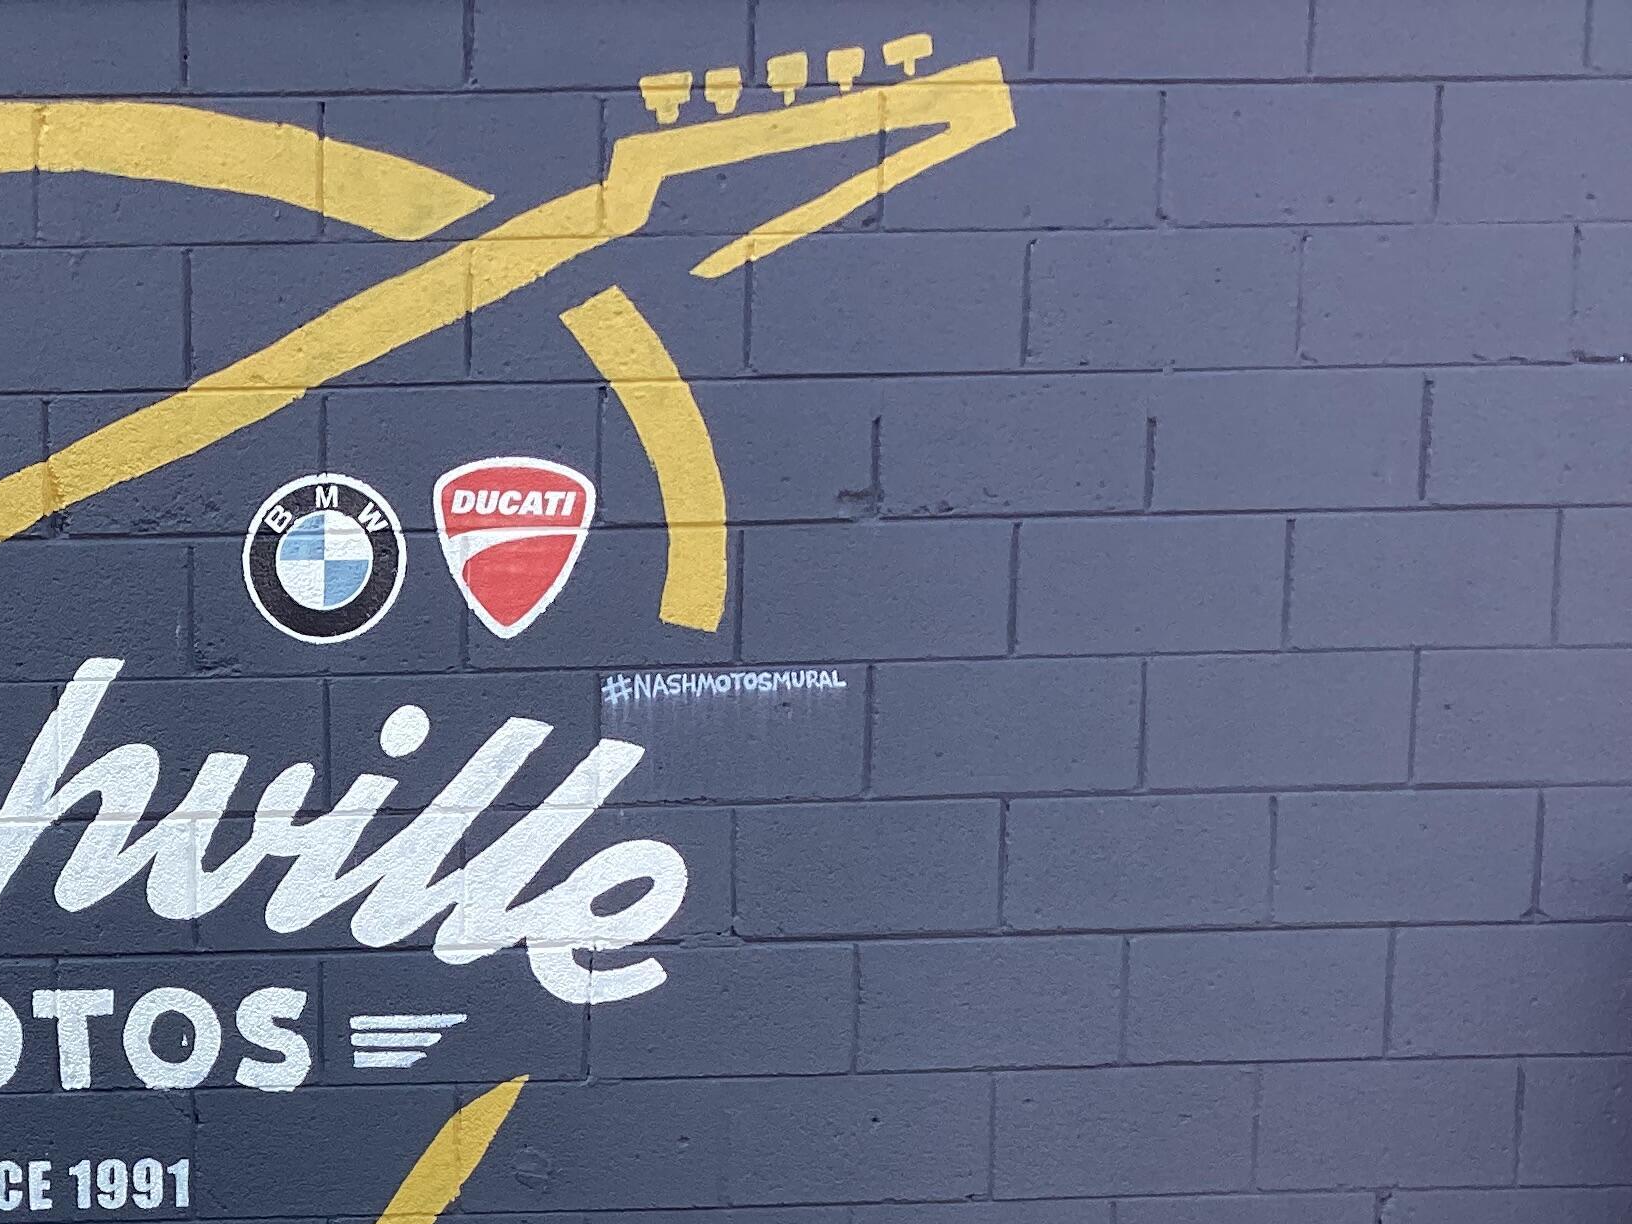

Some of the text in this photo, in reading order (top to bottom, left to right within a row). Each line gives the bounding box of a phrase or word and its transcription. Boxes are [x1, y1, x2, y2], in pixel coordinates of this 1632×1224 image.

[265, 485, 389, 535] BMW
[450, 489, 577, 517] DUCATI
[600, 669, 848, 705] #NASHMOTOSMURAL
[68, 1157, 190, 1210] 1991
